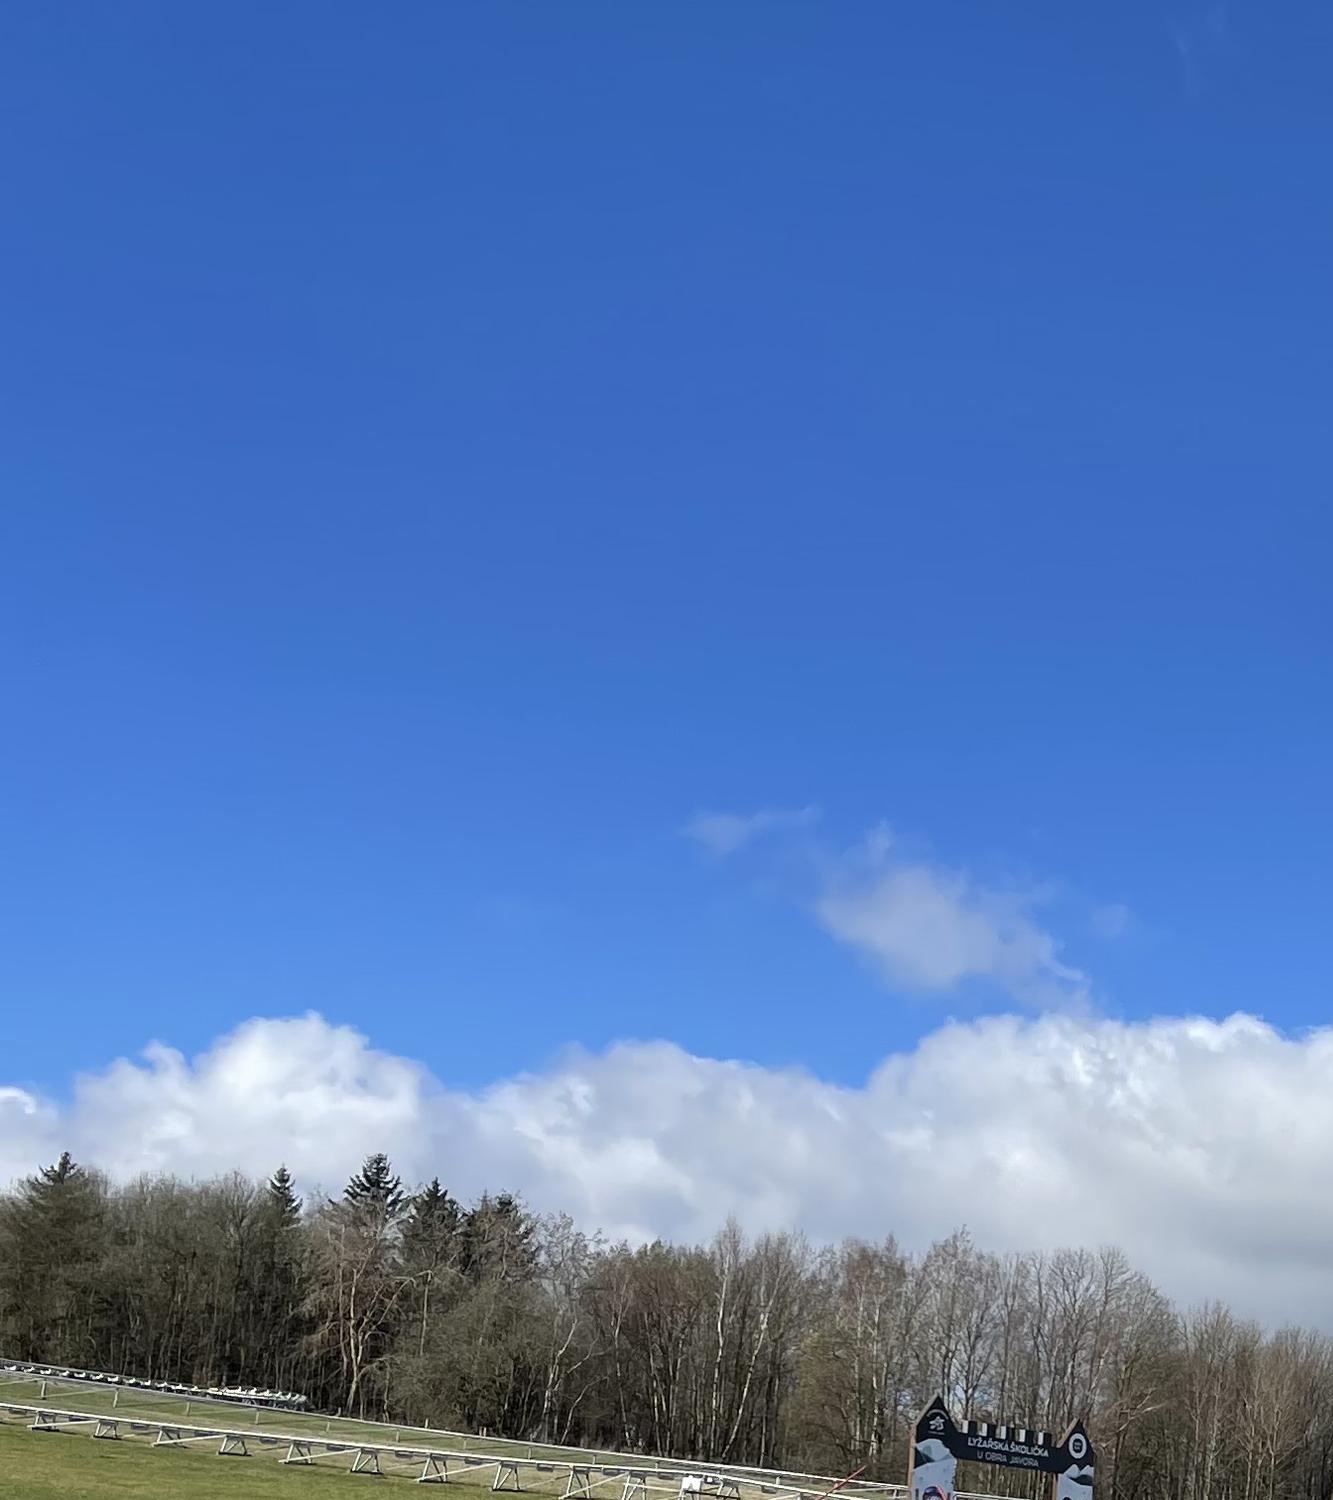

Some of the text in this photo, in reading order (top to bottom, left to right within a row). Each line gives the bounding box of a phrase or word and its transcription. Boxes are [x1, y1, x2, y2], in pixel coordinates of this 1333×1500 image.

[968, 1437, 1049, 1457] LYŽAŘSKÁ ŠKOLIČKA
[977, 1450, 1039, 1467] U OBRA JAVORA
